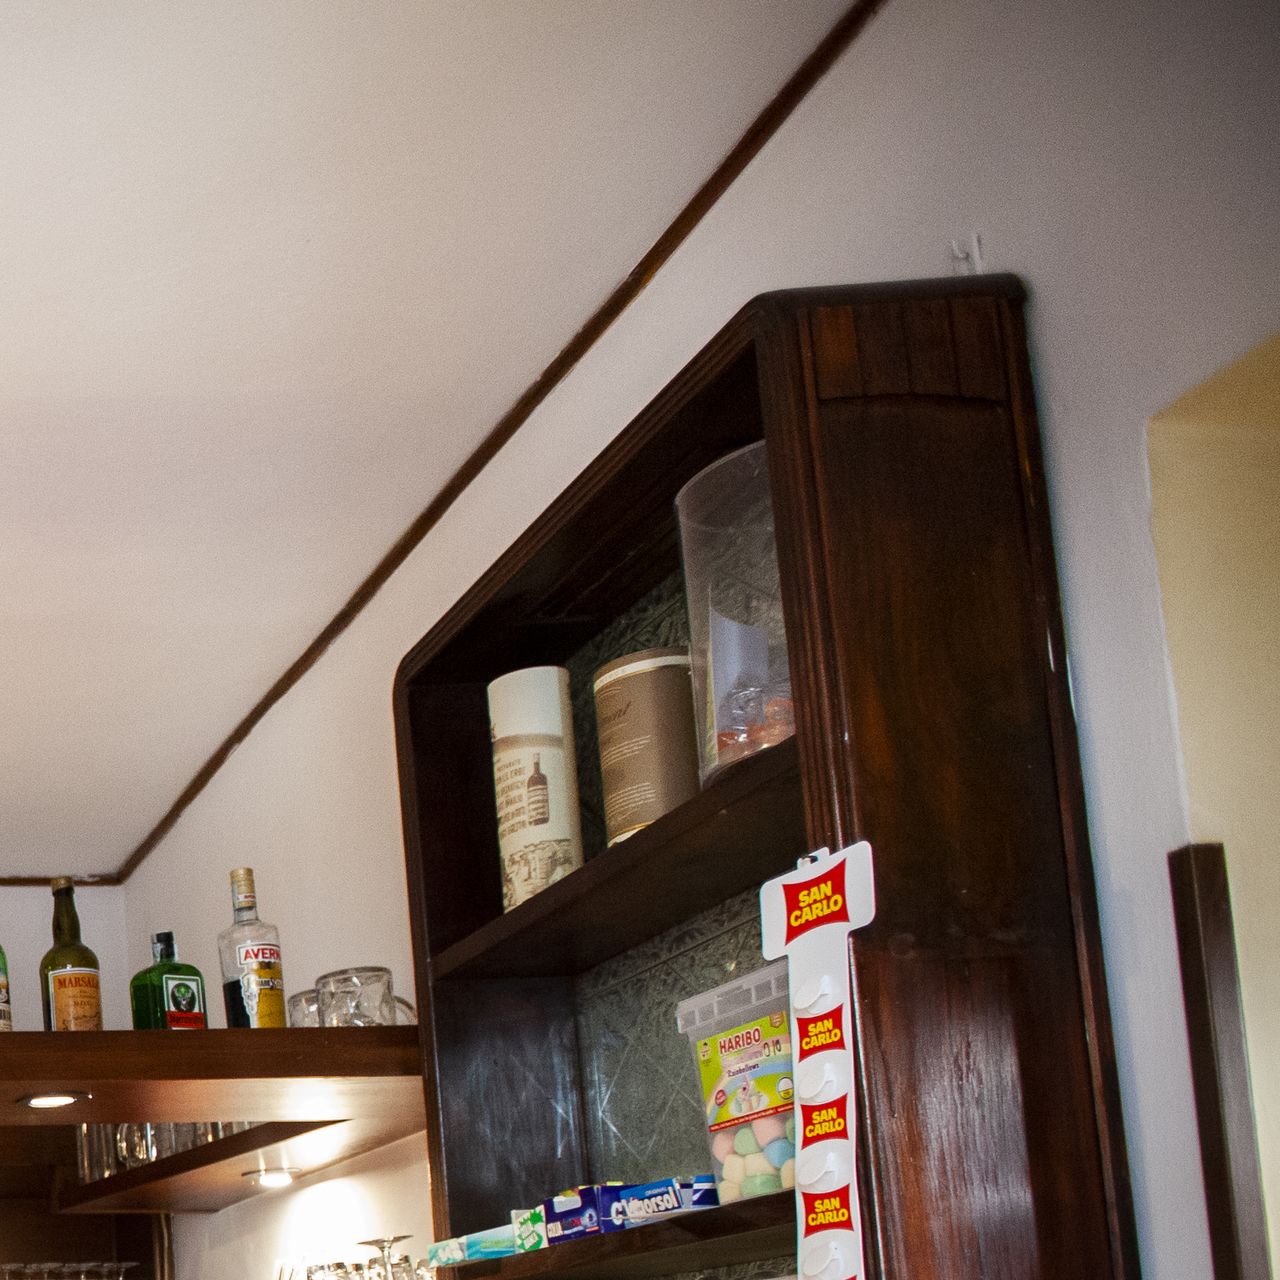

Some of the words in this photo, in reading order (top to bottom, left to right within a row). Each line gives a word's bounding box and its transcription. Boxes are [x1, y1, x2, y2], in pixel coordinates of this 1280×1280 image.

[798, 880, 832, 907] SAN
[790, 894, 843, 927] CARLO
[57, 975, 100, 989] MARSAL
[807, 1018, 833, 1036] SAN
[719, 1028, 761, 1054] HARIBO
[801, 1028, 841, 1050] CARLO
[812, 1107, 837, 1124] SAN
[805, 1118, 845, 1137] CARLO
[814, 1196, 840, 1213] SAN
[807, 1208, 849, 1226] CARLO
